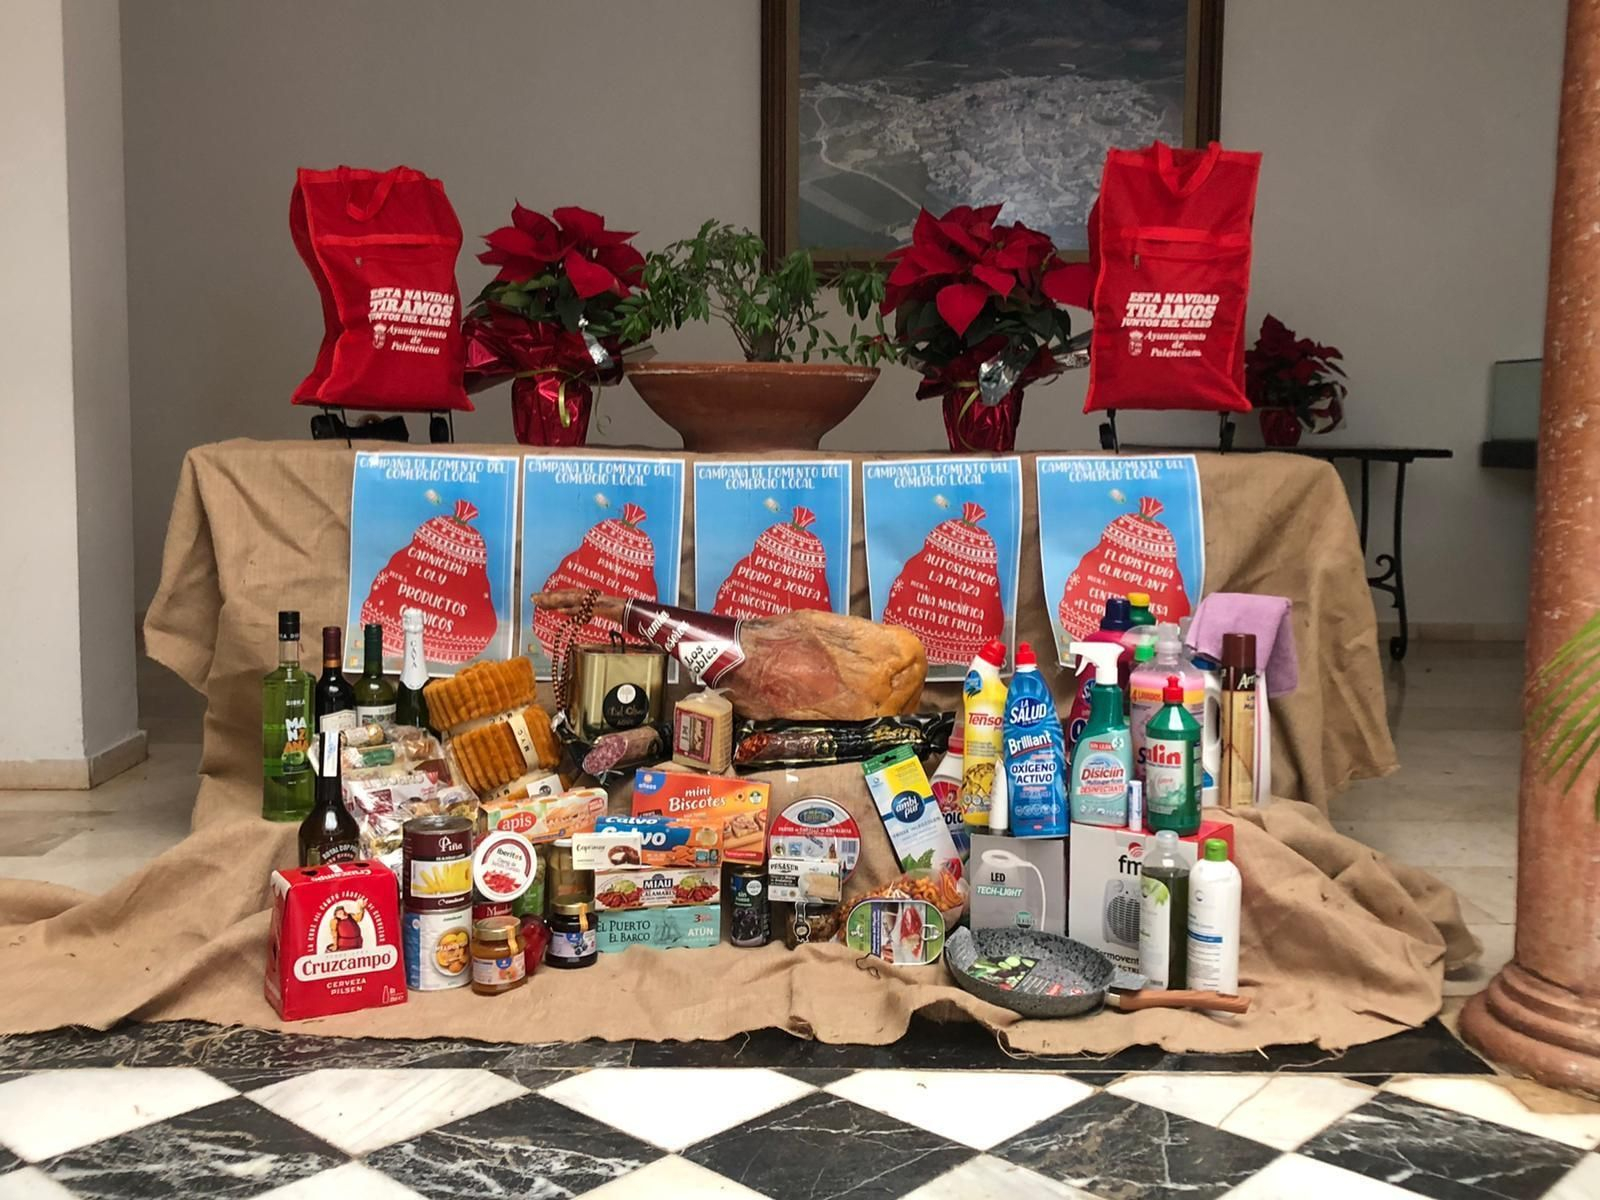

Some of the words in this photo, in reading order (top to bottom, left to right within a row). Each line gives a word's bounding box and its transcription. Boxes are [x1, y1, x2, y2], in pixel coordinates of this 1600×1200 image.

[370, 288, 402, 299] ESTA
[1129, 292, 1161, 303] ESTA
[1164, 293, 1220, 305] NAVIDAD
[369, 299, 454, 318] TIRAMOS
[1126, 303, 1217, 319] TIRAMOS
[368, 312, 401, 323] JUNTOS
[401, 314, 419, 323] DEL
[420, 316, 451, 327] CARRO
[1121, 317, 1160, 328] JUNTOS
[1161, 319, 1180, 328] DEL
[1181, 319, 1212, 328] CARRO
[387, 324, 447, 339] Ayuntamiento
[1144, 331, 1206, 342] Ayuntamiento
[410, 335, 422, 344] de
[1171, 340, 1184, 349] de
[391, 341, 440, 355] Palenciana
[1150, 348, 1202, 358] Palenciana
[414, 460, 426, 470] DE
[431, 460, 484, 473] FOMENTO
[487, 462, 507, 474] DEL
[582, 463, 593, 474] DE
[600, 463, 650, 476] FOMENTO
[654, 464, 674, 477] DEL
[752, 466, 763, 478] DE
[768, 466, 818, 479] FOMENTO
[821, 466, 840, 478] DEL
[920, 464, 932, 477] DE
[936, 463, 987, 476] FOMENTO
[991, 462, 1009, 474] DEL
[1095, 460, 1106, 473] DE
[1111, 459, 1163, 472] FOMENTO
[1166, 459, 1184, 470] DEL
[386, 468, 440, 481] COMERCIO
[444, 470, 479, 483] LOCAL
[555, 472, 609, 485] COMERCIO
[612, 475, 647, 486] LOCAL
[894, 475, 947, 488] COMERCIO
[950, 474, 984, 486] LOCAL
[1069, 470, 1122, 483] COMERCIO
[1125, 469, 1159, 480] LOCAL
[725, 478, 778, 490] COMERCIO
[781, 478, 815, 489] LOCAL
[416, 565, 448, 584] LOLY
[737, 566, 771, 585] PEDRO
[783, 581, 821, 601] JOSEFA
[929, 570, 942, 584] LA
[945, 576, 981, 597] PLAZA
[398, 583, 468, 617] PRODUCTOS
[917, 592, 936, 607] UNA
[399, 604, 454, 633] CNICOS
[908, 606, 936, 623] CESTA
[938, 616, 949, 626] DE
[951, 618, 982, 635] FRUTA
[664, 621, 690, 652] eserva
[1010, 702, 1047, 725] SALUD
[1008, 732, 1053, 756] Brilliant
[1011, 761, 1056, 774] OXÍGENO
[1016, 774, 1052, 784] ACTIVO
[685, 785, 711, 797] mini
[668, 796, 727, 812] Biscotes
[896, 796, 919, 812] ambi
[904, 803, 919, 819] pur
[502, 815, 532, 832] apis
[644, 879, 673, 889] MIAU
[990, 872, 1006, 882] LED
[976, 885, 1023, 897] TECH-LIGHT
[610, 920, 651, 932] PUERTO
[609, 933, 617, 943] EL
[620, 932, 650, 943] BARCO
[302, 952, 391, 977] Cruzcampo
[326, 977, 367, 989] CERVEZA
[331, 985, 363, 996] PILSEN
